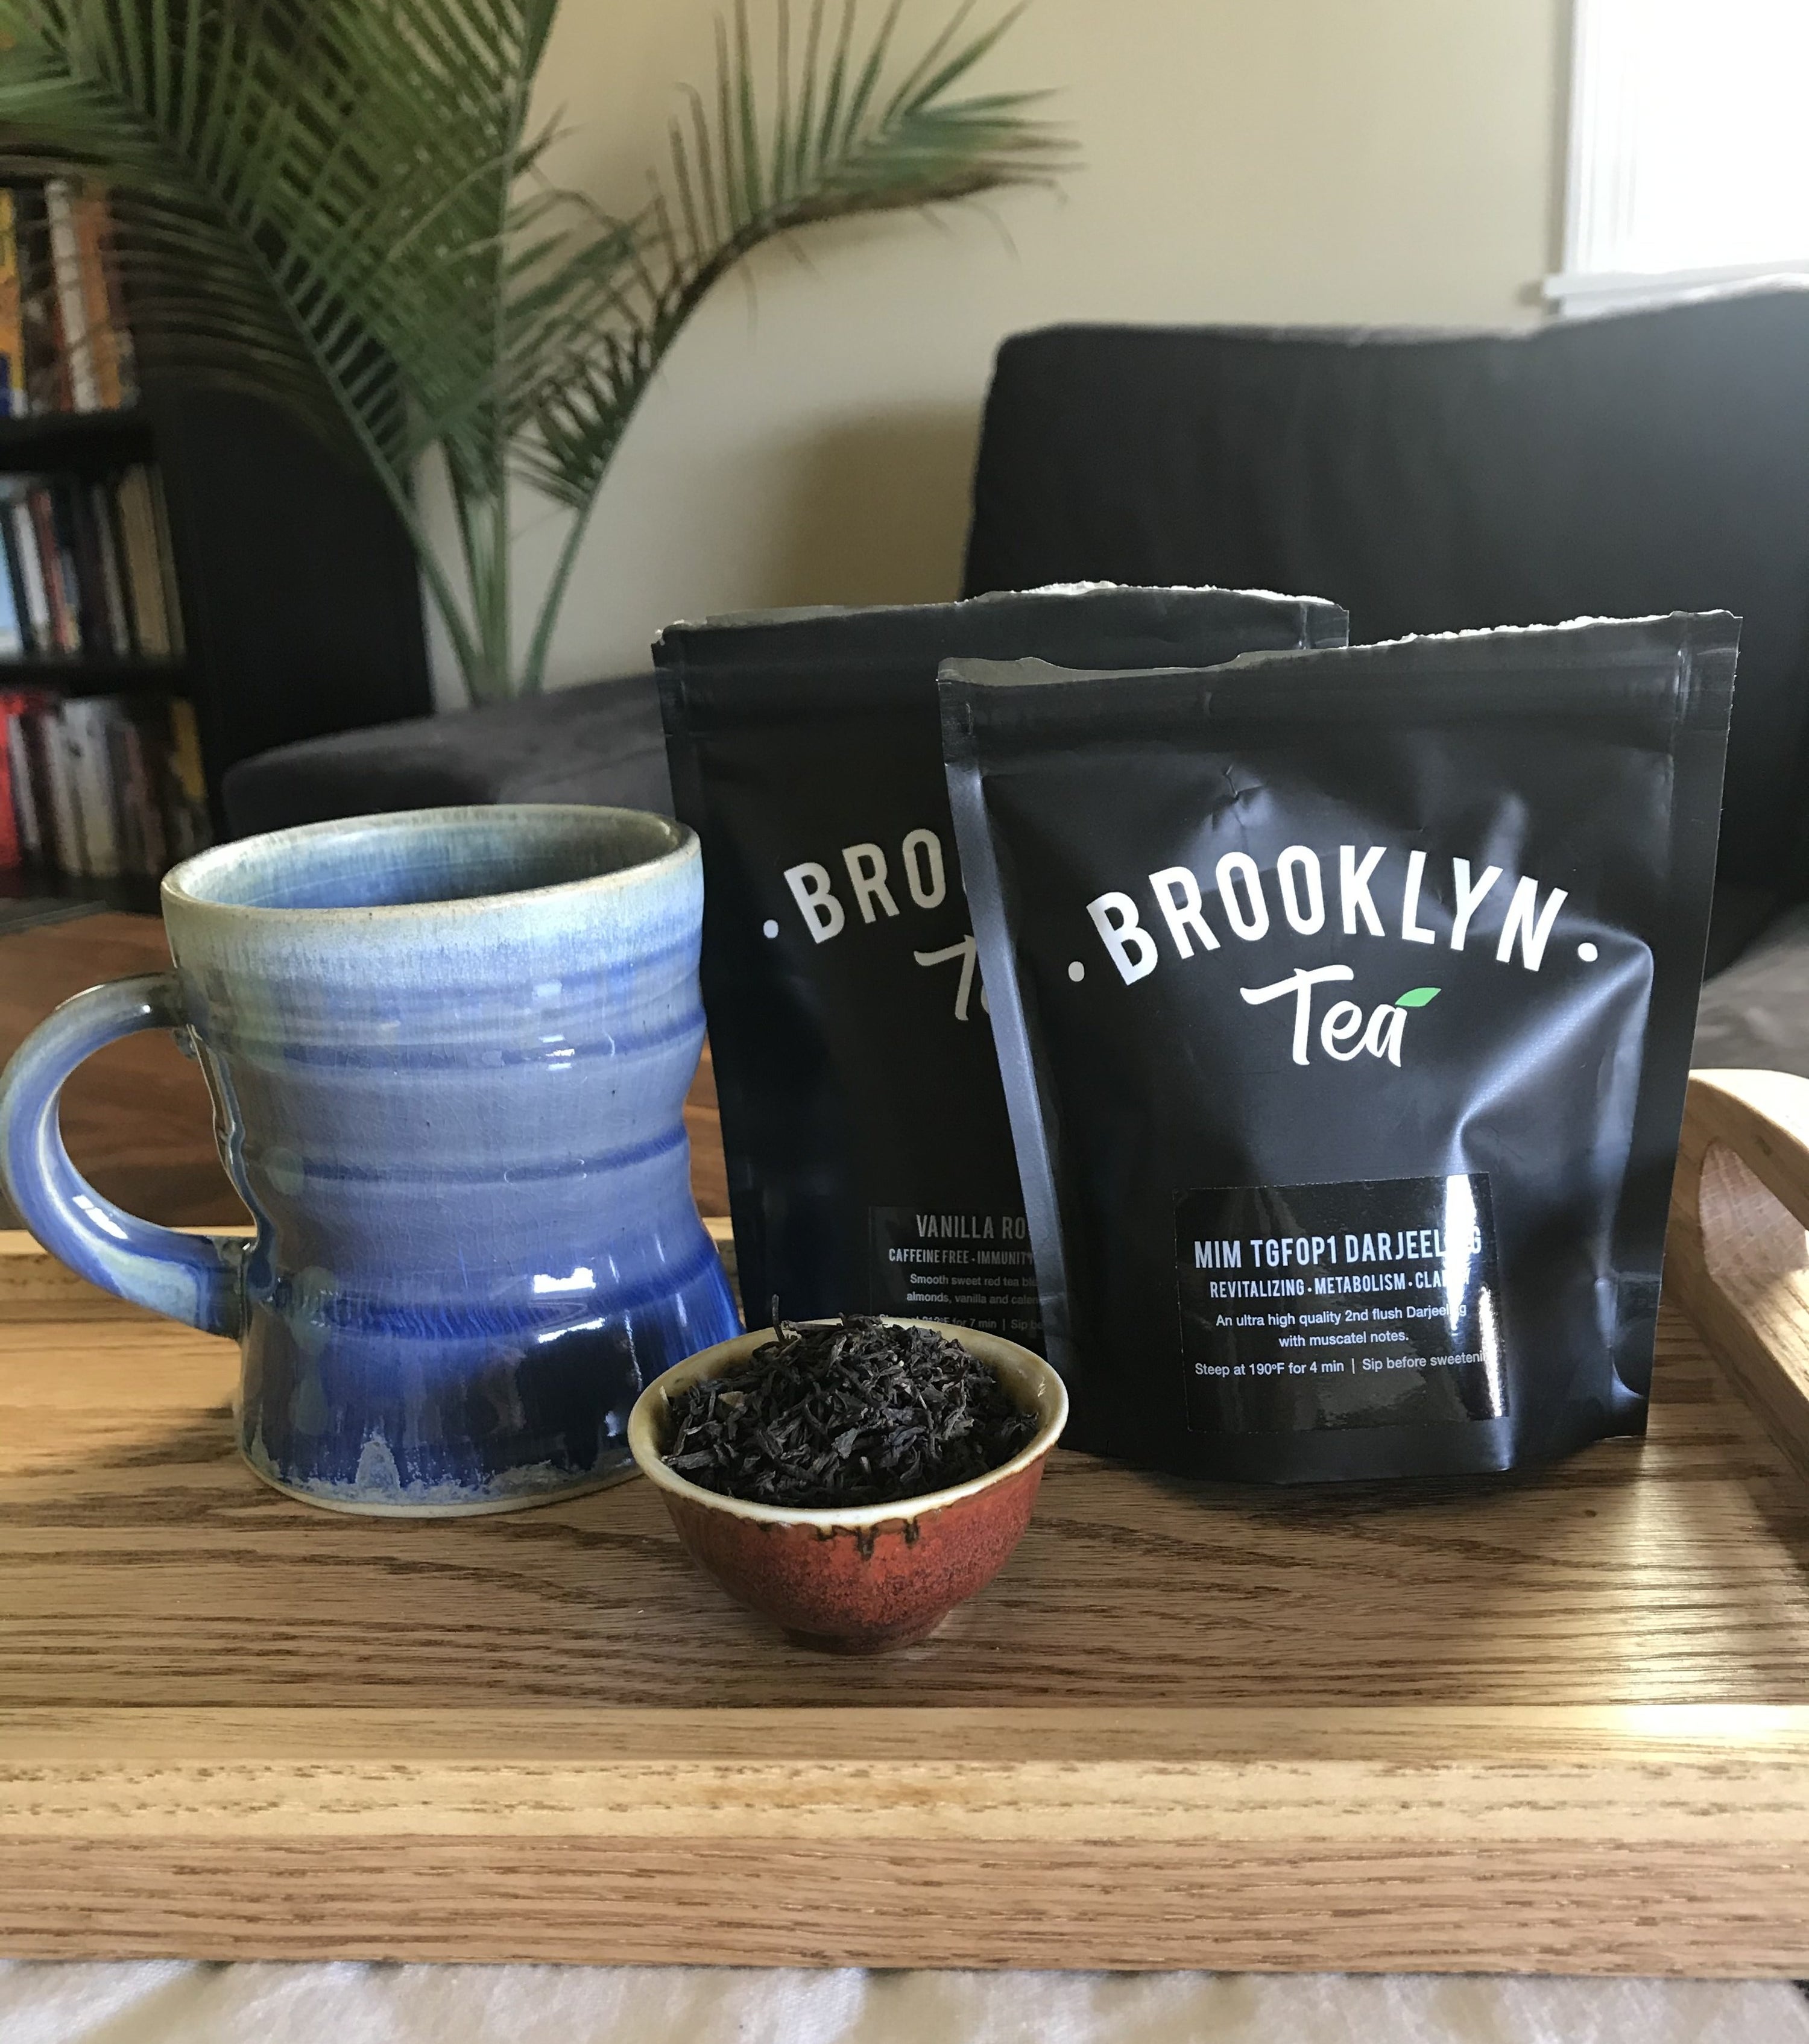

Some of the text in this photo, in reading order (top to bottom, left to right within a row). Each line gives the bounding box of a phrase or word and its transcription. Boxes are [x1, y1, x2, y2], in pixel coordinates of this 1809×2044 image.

[784, 828, 967, 944] BRO
[1086, 845, 1568, 985] BROOKLYN
[1240, 965, 1409, 1067] Tea
[916, 1214, 994, 1239] VANILLA
[1194, 1225, 1482, 1269] MIM TGFOP1 DARJEELG
[910, 1273, 1038, 1287] Smooth sweet red tea bl
[1210, 1267, 1470, 1298] REVITALIZING METABOLISM CLAY
[906, 1292, 952, 1304] almonds,
[955, 1294, 987, 1304] vanilla
[990, 1295, 1008, 1304] and
[969, 1318, 976, 1328] 7
[978, 1318, 997, 1329] min
[1011, 1319, 1028, 1331] Sip
[1216, 1302, 1466, 1329] An ultra high quality 2nd flush Darjeelg
[1279, 1331, 1409, 1348] with muscatel notes.
[1195, 1363, 1230, 1378] Steep
[1233, 1363, 1246, 1375] at
[1288, 1361, 1307, 1374] for
[1310, 1361, 1318, 1374] 4
[1321, 1360, 1344, 1373] min
[1362, 1358, 1383, 1375] Sip
[1386, 1355, 1427, 1370] before
[1430, 1351, 1485, 1367] sweeteni
